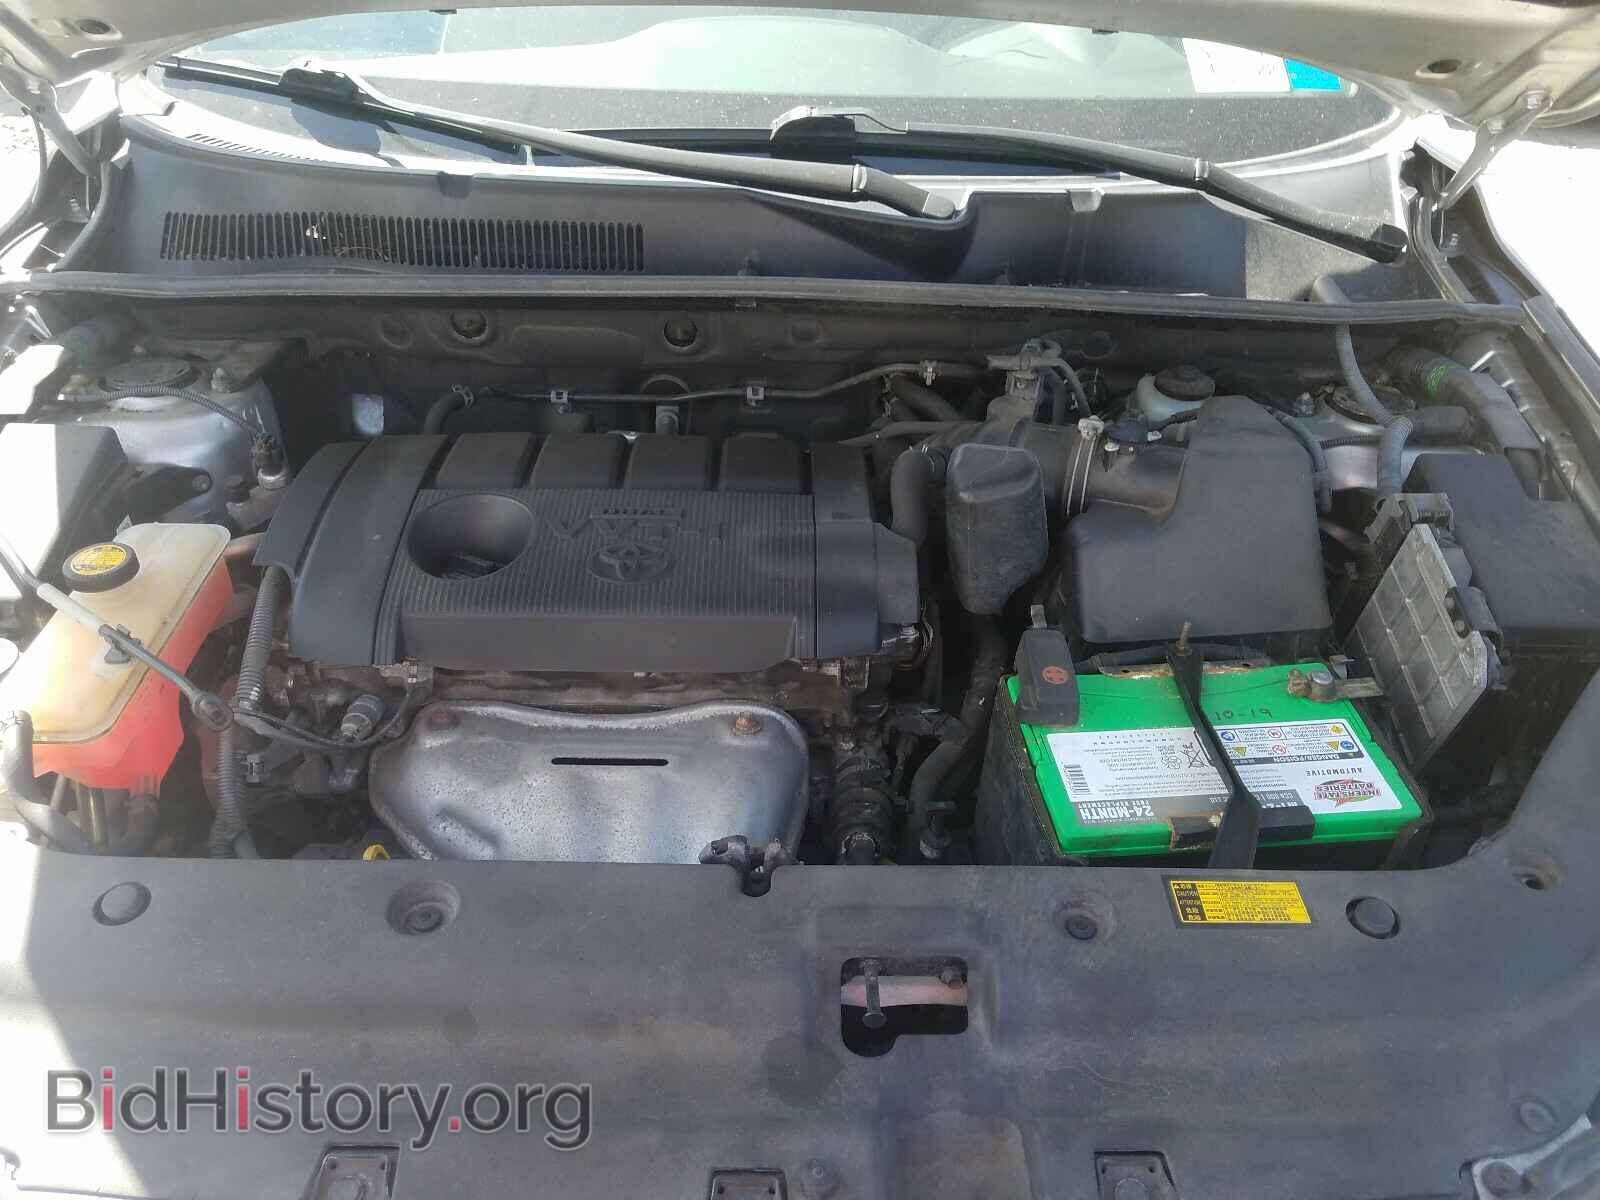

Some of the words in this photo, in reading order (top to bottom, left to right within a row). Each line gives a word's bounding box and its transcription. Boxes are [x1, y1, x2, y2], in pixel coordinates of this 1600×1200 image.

[1305, 767, 1363, 777] AUTOMOTIVE
[1315, 782, 1375, 793] BATTERIES
[1313, 789, 1382, 802] INTERSTATE
[1079, 804, 1155, 819] 24-MONTH
